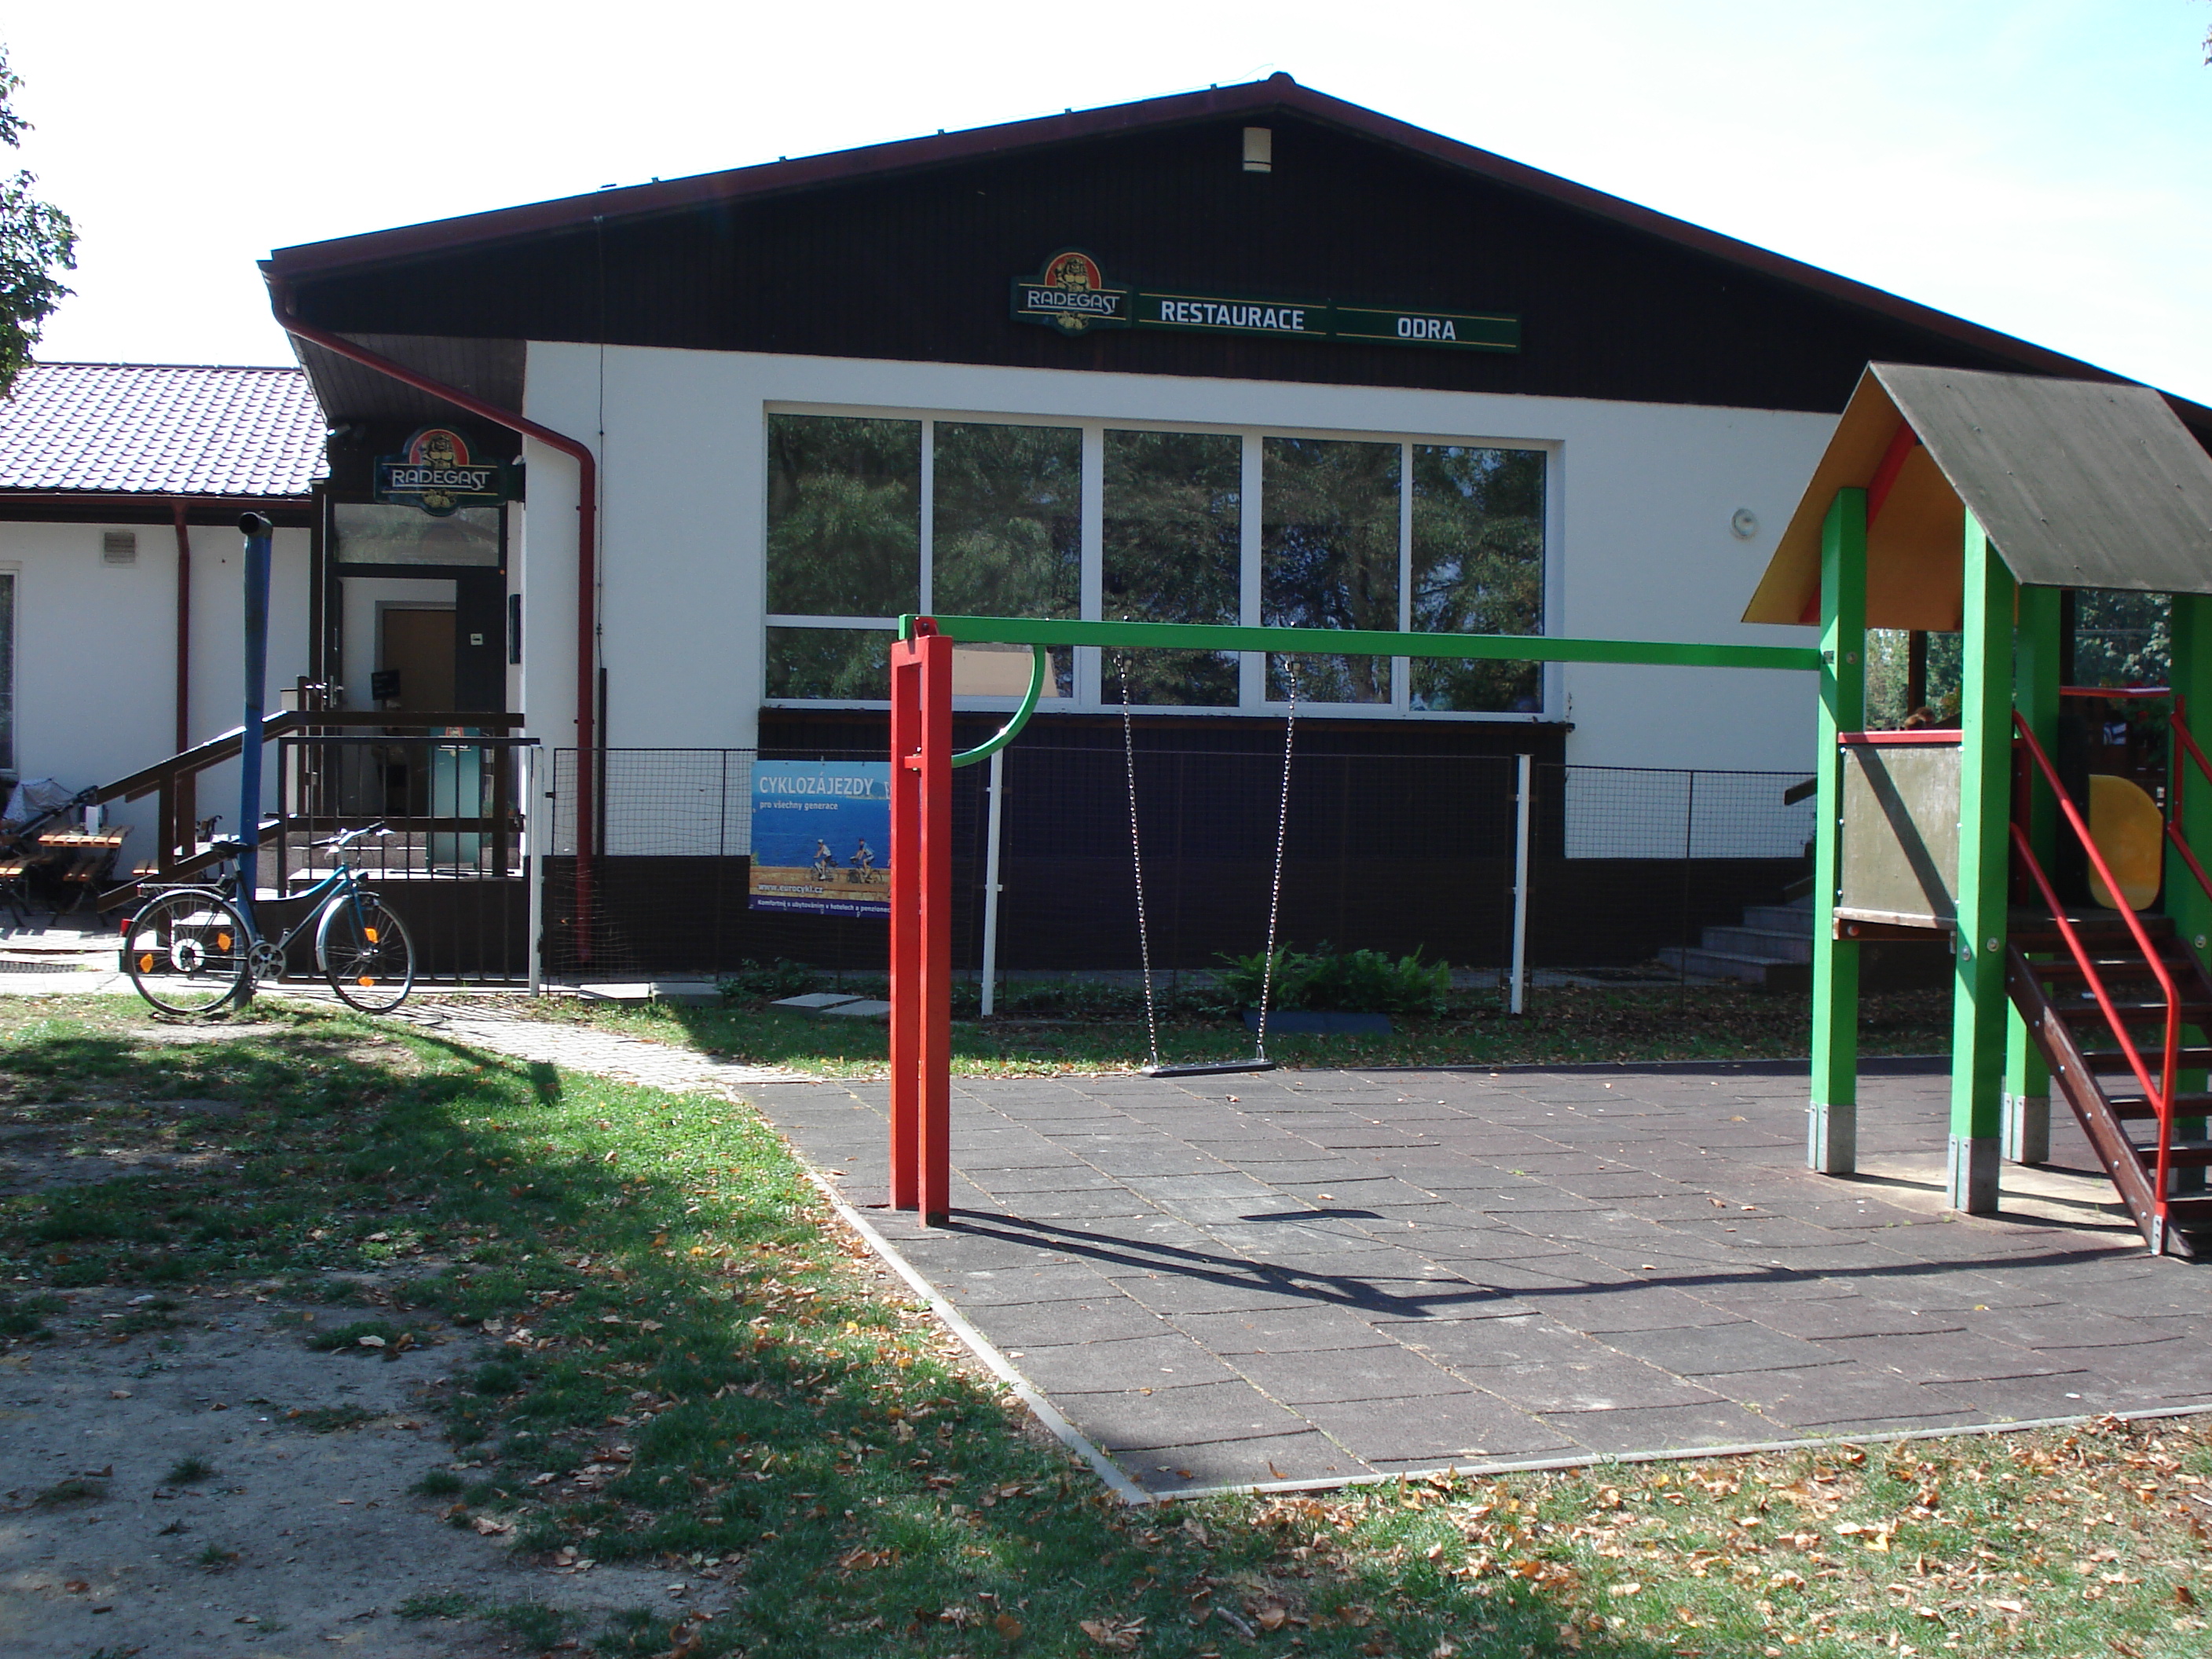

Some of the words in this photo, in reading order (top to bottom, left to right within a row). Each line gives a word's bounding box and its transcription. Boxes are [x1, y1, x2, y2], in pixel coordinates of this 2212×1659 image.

[1027, 290, 1121, 315] RADEGAST
[1161, 300, 1305, 331] RESTAURACE
[1397, 317, 1457, 341] ODRA
[392, 469, 491, 492] RADEGAST
[759, 771, 874, 796] CYKLOZÁJEZDY
[759, 801, 771, 810] pro
[774, 800, 803, 811] všechny
[804, 802, 838, 811] generace
